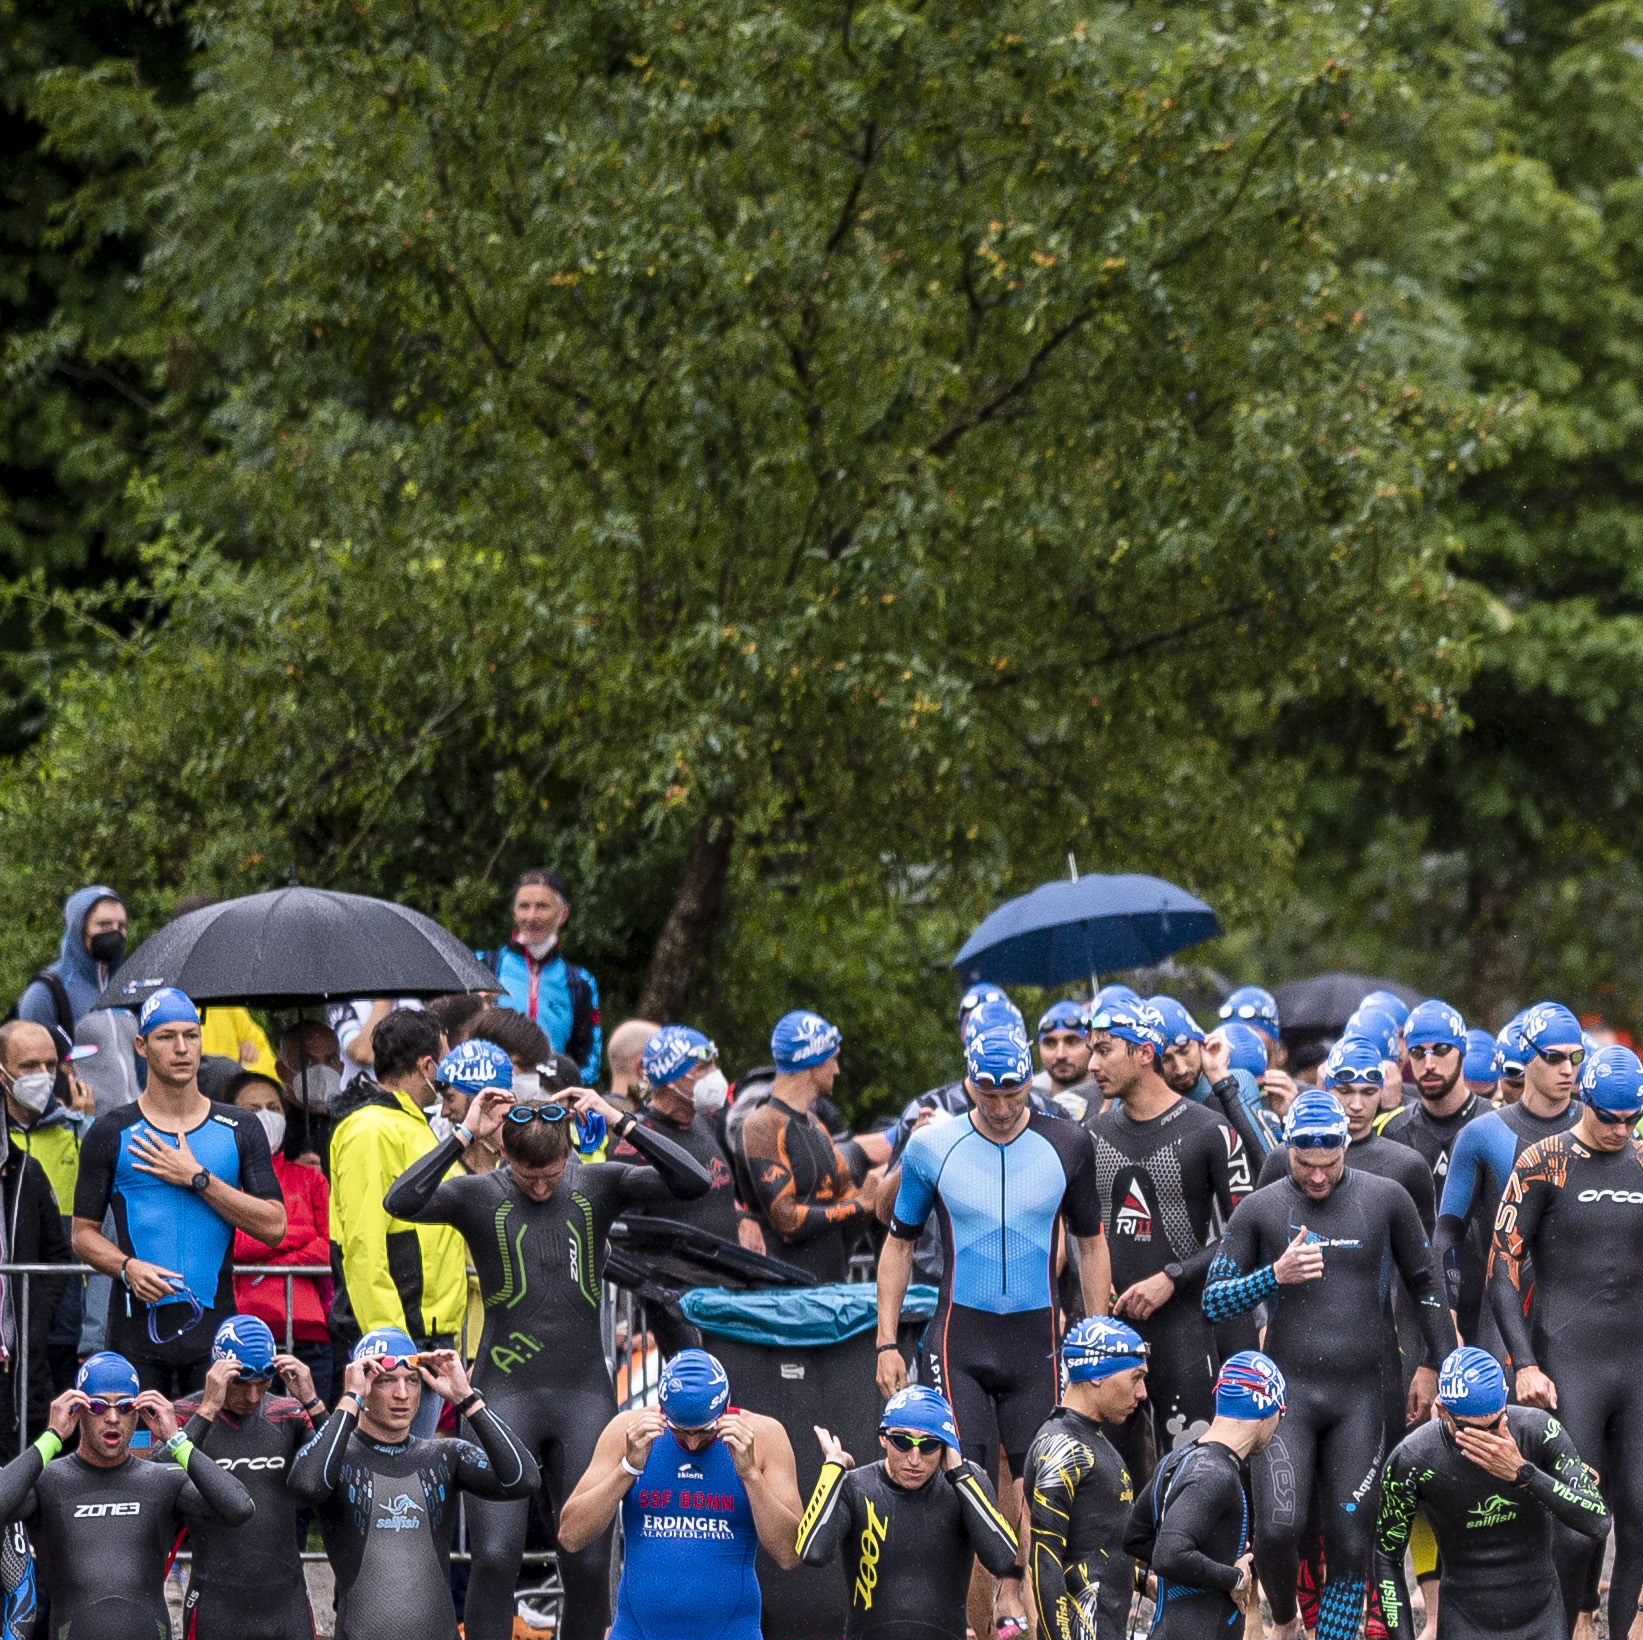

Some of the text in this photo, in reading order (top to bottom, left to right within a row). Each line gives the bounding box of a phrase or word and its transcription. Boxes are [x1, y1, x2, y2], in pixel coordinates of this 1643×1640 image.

[443, 1058, 496, 1083] Kult
[1117, 1219, 1151, 1235] TRI 11
[568, 1236, 578, 1282] 2XU
[1441, 1375, 1469, 1398] ult
[1355, 1469, 1376, 1502] Aqua
[1552, 1479, 1606, 1515] Vibrant
[74, 1502, 140, 1518] ZONE3
[639, 1489, 734, 1511] SSF BONN
[642, 1515, 731, 1532] ERDINGER
[1466, 1511, 1517, 1529] sailfish
[1380, 1579, 1397, 1629] sailfish
